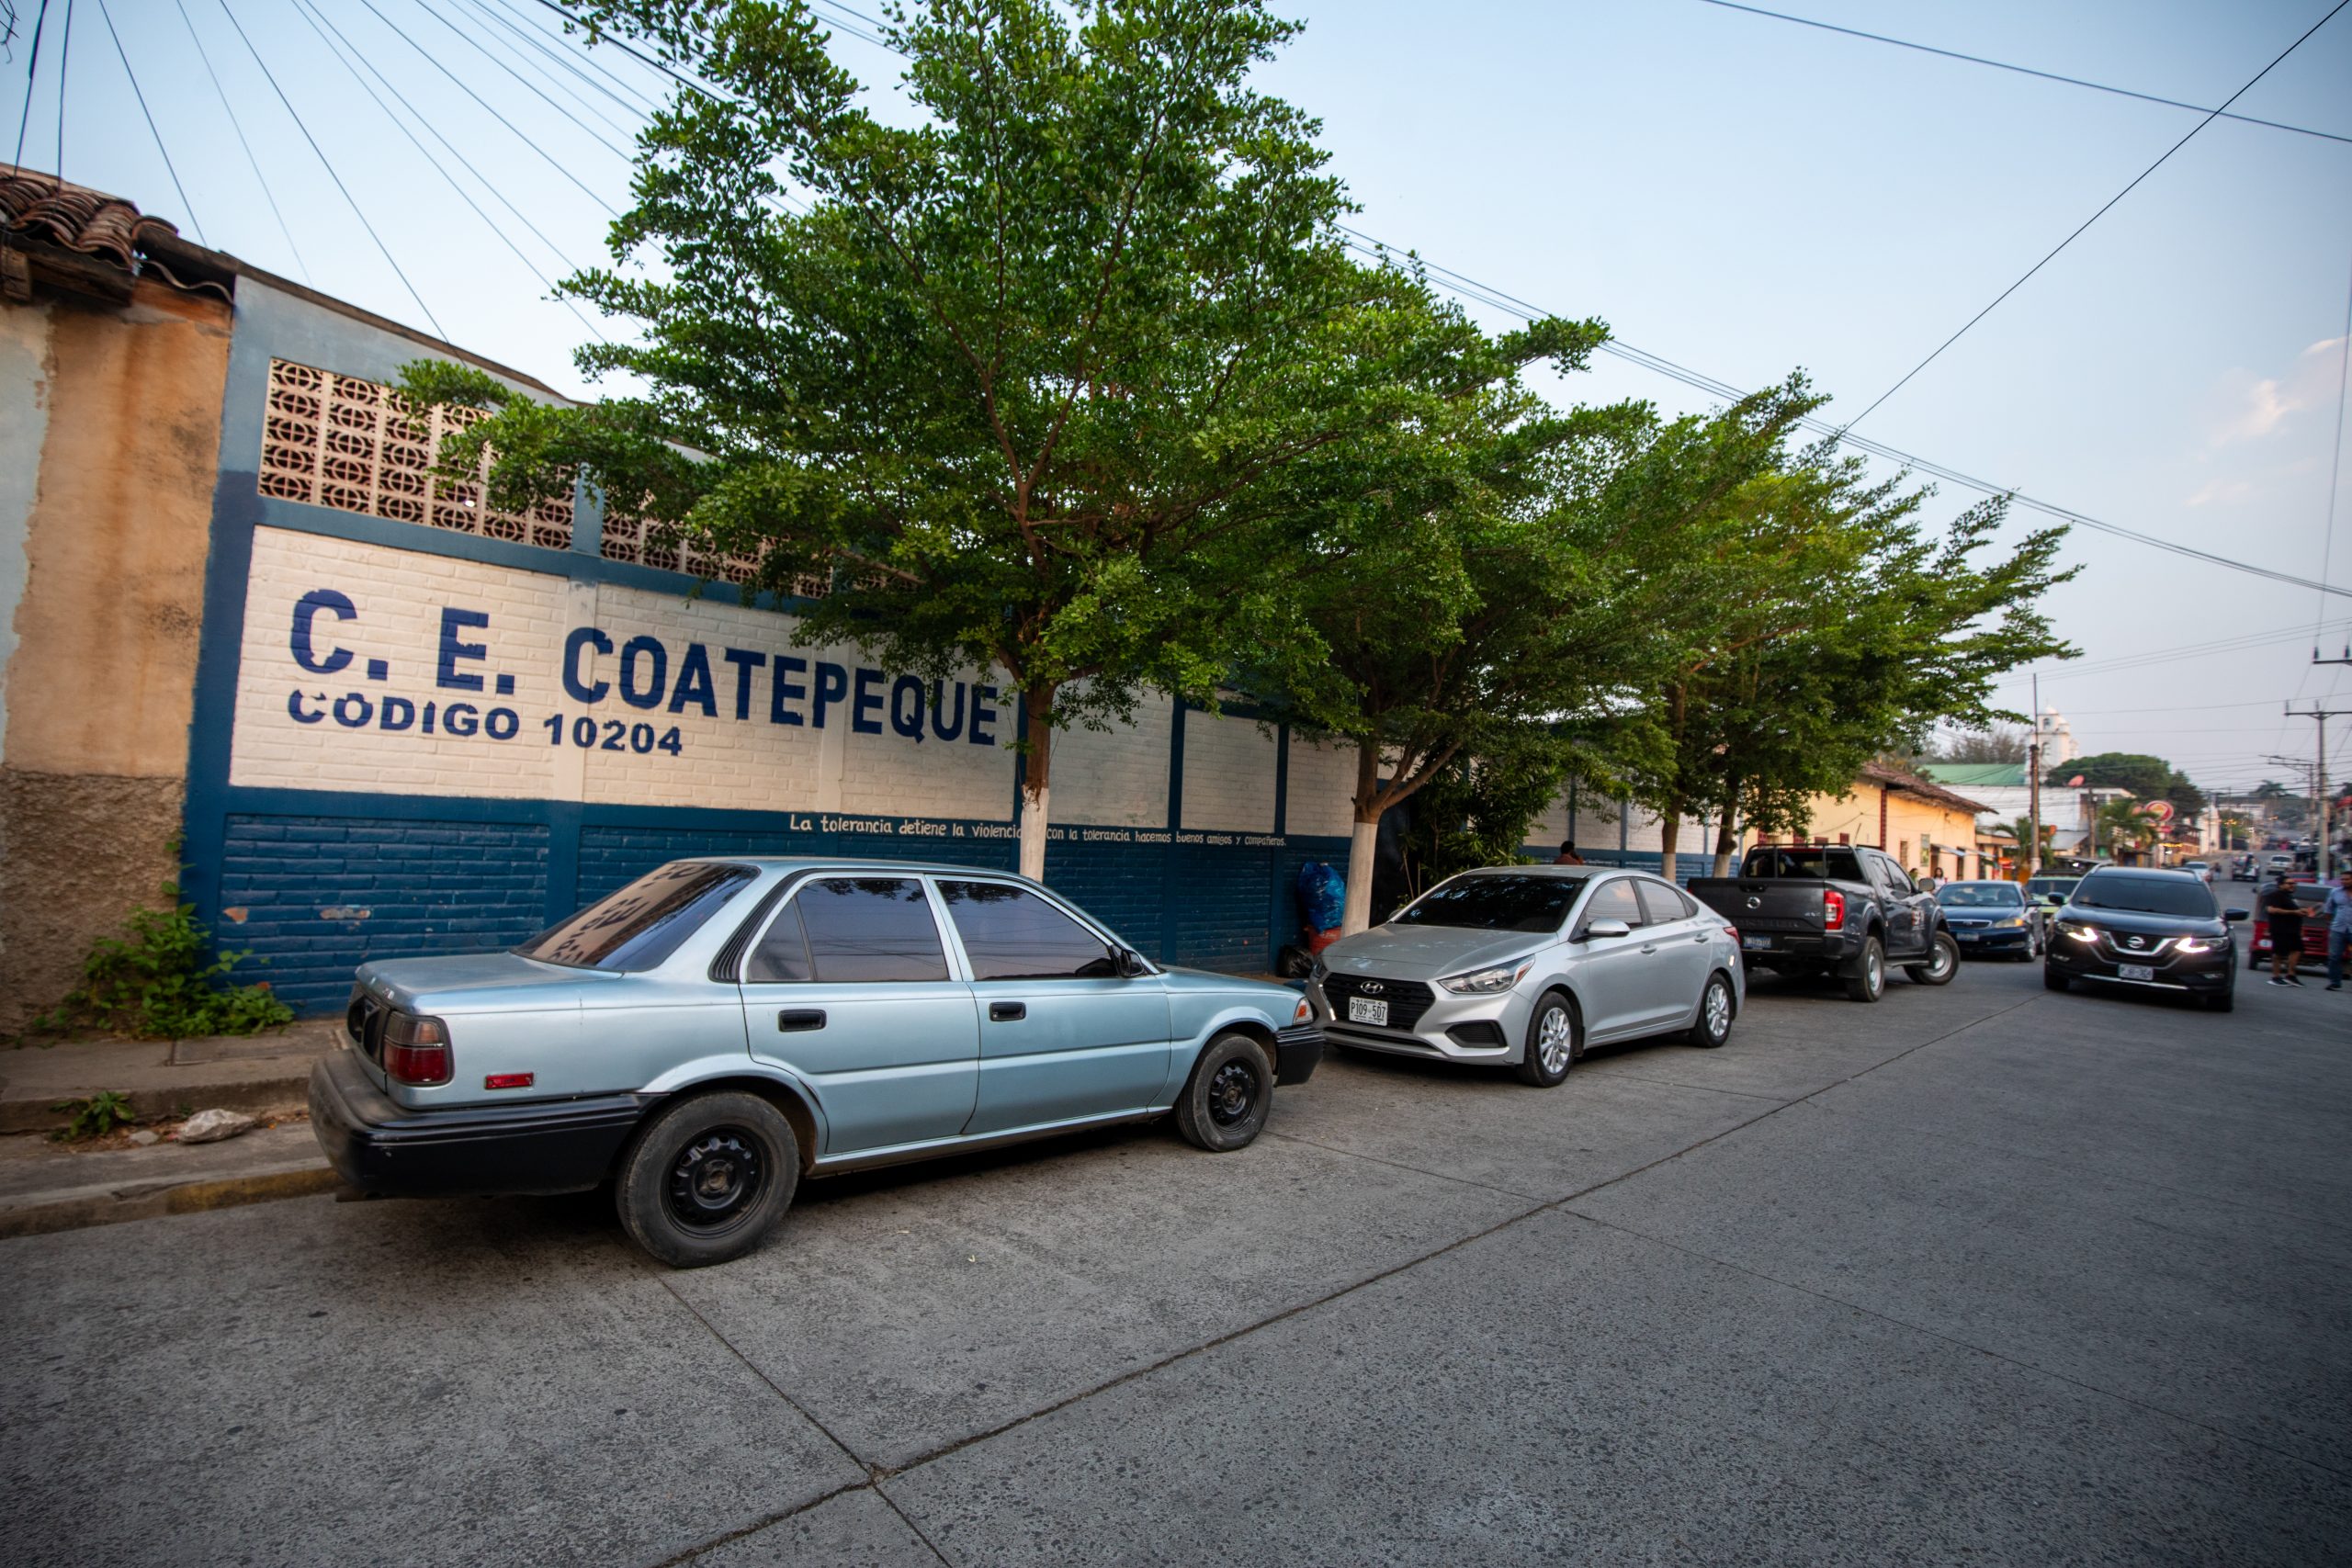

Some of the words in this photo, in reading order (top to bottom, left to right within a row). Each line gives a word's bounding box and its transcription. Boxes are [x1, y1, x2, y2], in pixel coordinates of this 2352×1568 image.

[289, 589, 388, 681] C.
[436, 607, 514, 694] E.
[562, 627, 998, 746] COATEPEQUE
[543, 714, 683, 756] 10204
[790, 814, 812, 831] La
[820, 815, 892, 833] tolerancia
[899, 819, 946, 837] detiene
[952, 823, 965, 837] la
[1069, 829, 1078, 840] la
[1082, 829, 1130, 841] tolerancia
[1135, 831, 1171, 842] hacemos
[1176, 830, 1204, 843] buenos
[1206, 833, 1232, 845] amigos
[1236, 835, 1241, 845] y
